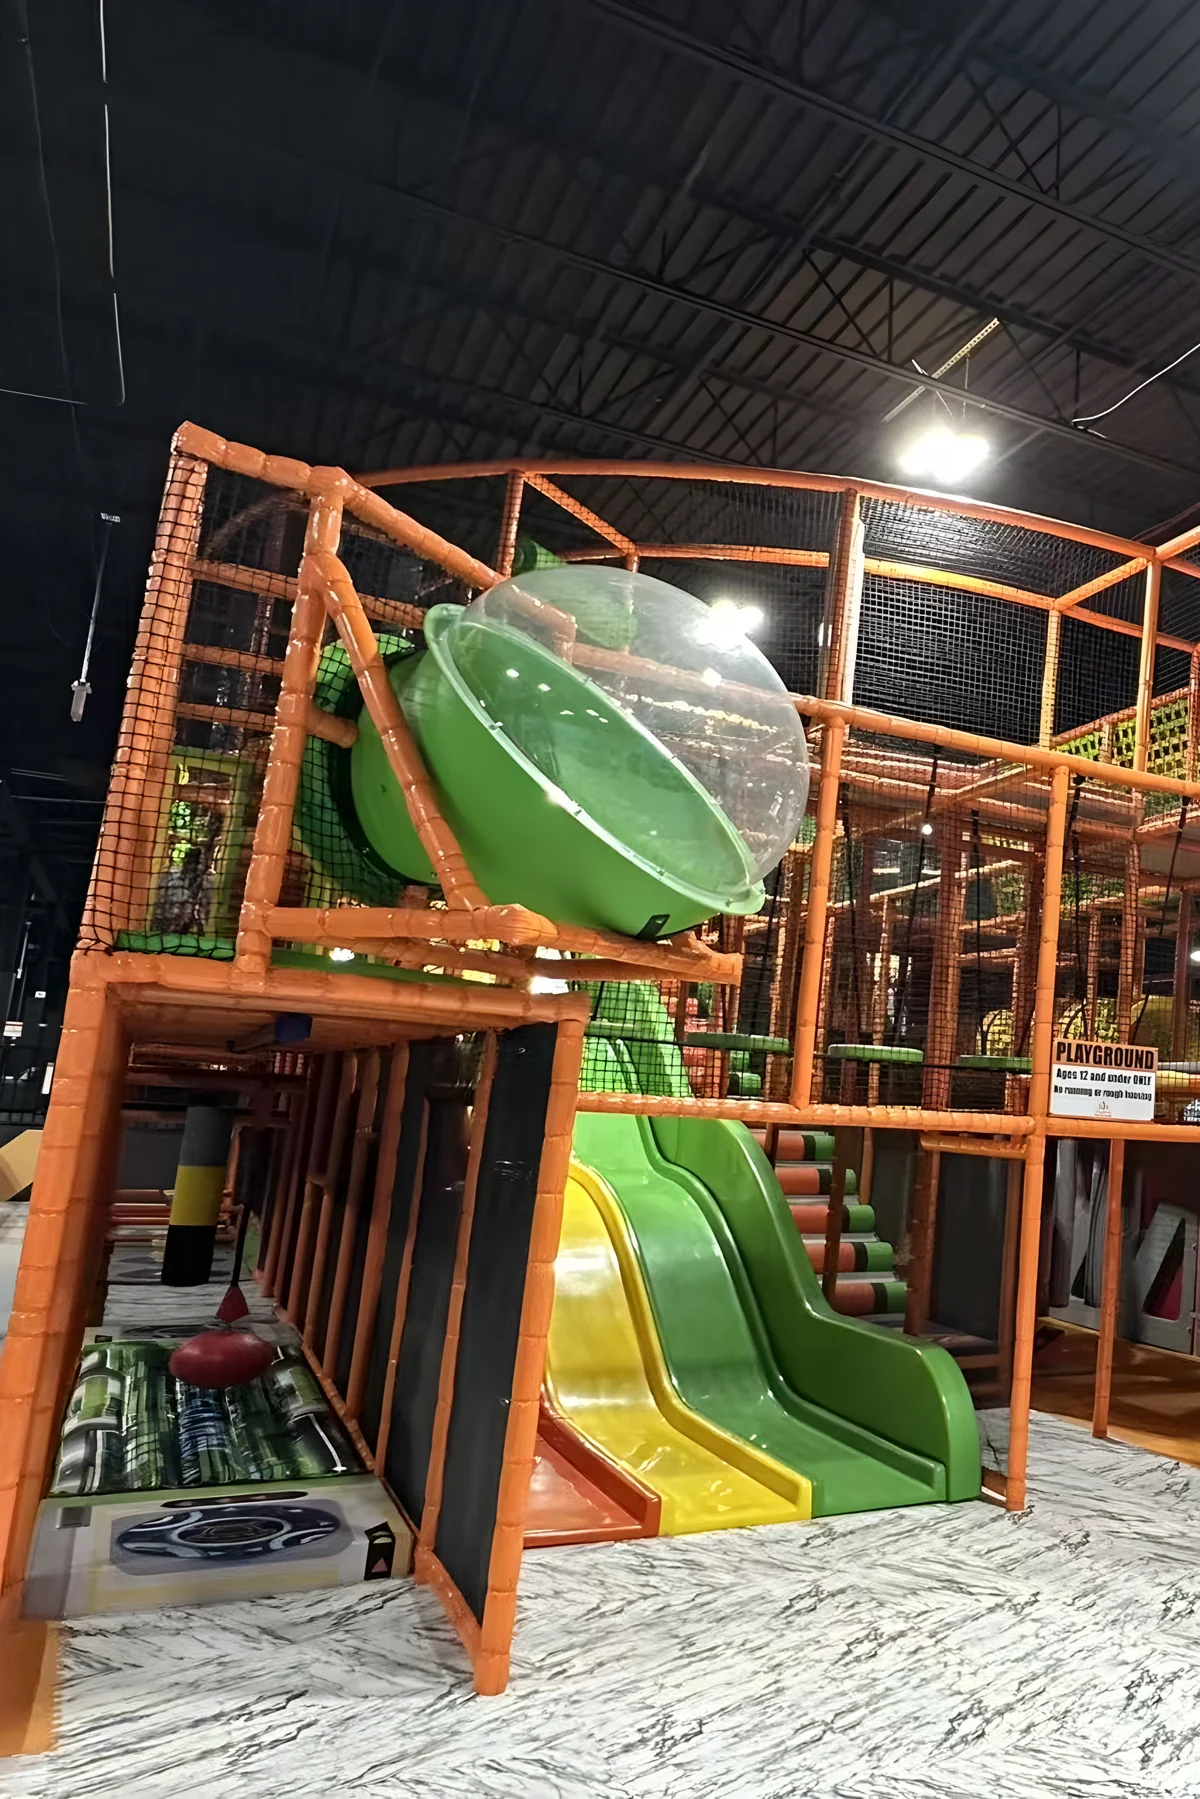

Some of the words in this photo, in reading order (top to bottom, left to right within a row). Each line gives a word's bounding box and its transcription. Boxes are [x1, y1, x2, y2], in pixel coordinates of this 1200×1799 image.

[1056, 1041, 1154, 1070] PLAYGROUND
[1056, 1067, 1077, 1080] Ages
[1079, 1070, 1088, 1081] 12
[1090, 1072, 1106, 1083] and
[1107, 1074, 1131, 1085] under
[1053, 1084, 1063, 1094] No
[1094, 1089, 1102, 1097] or
[1103, 1089, 1123, 1099] rough
